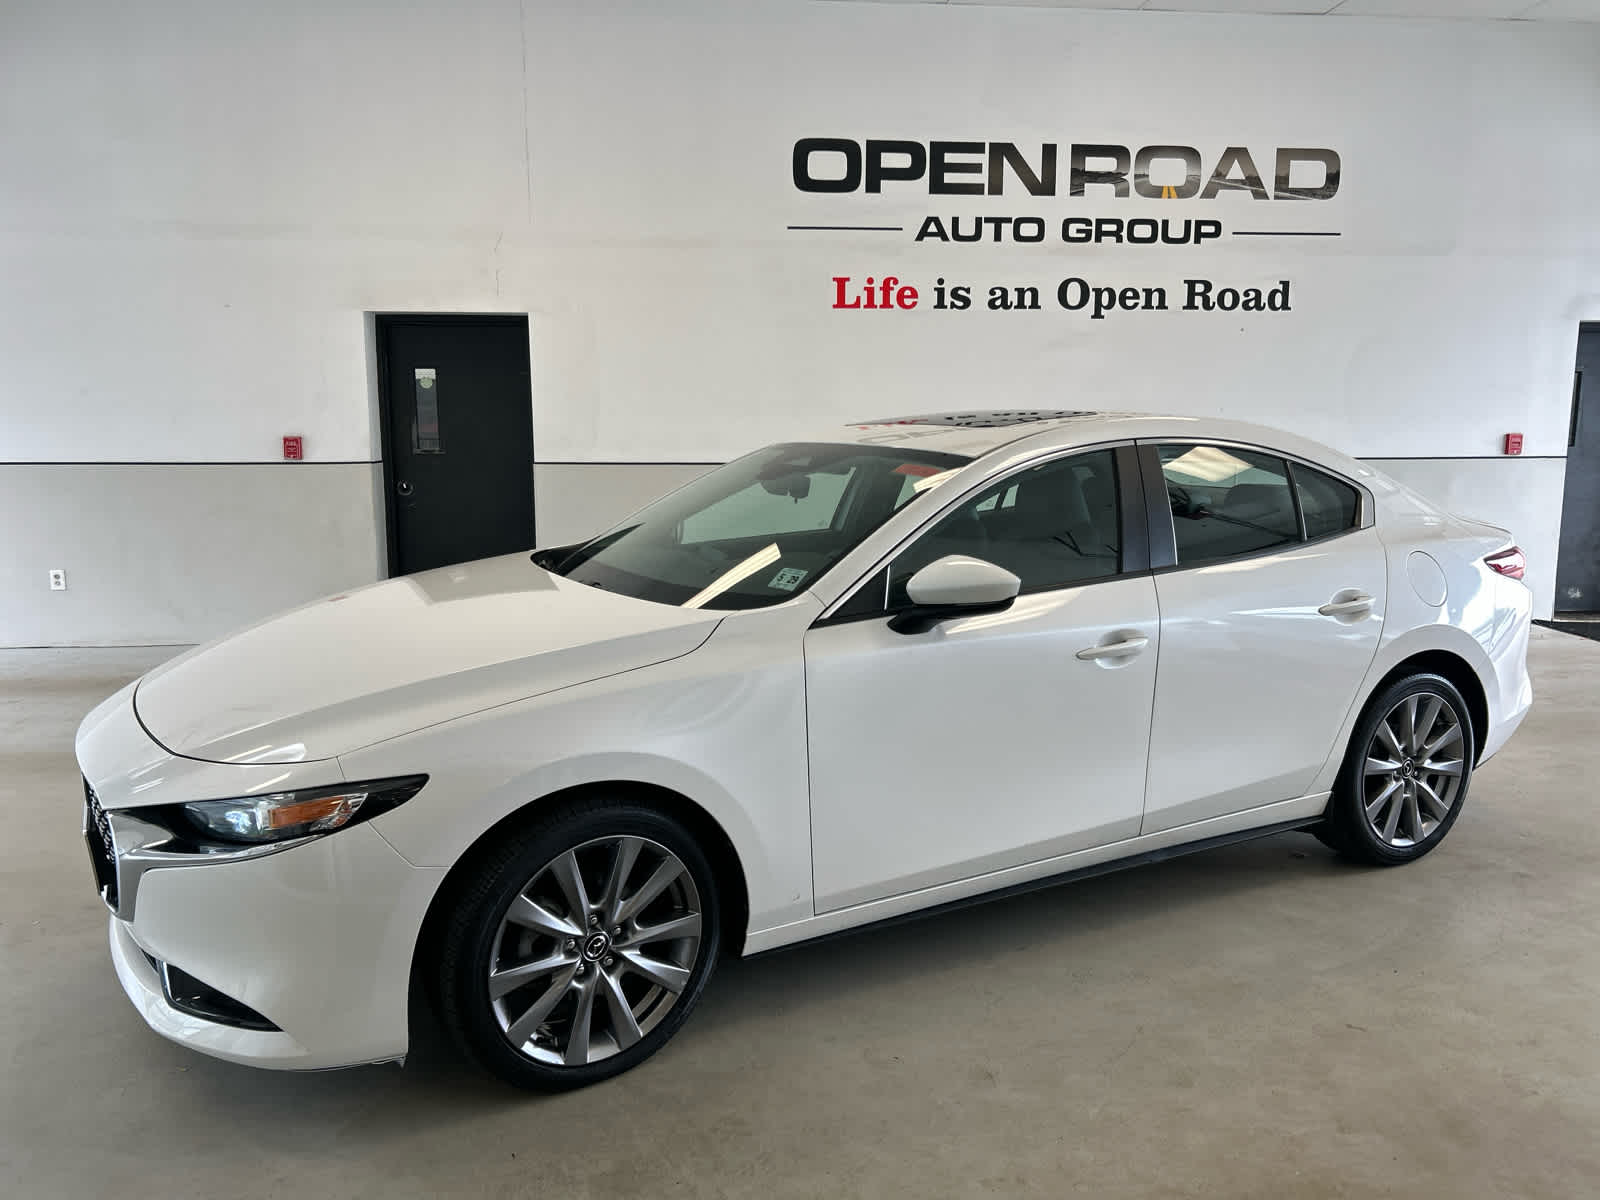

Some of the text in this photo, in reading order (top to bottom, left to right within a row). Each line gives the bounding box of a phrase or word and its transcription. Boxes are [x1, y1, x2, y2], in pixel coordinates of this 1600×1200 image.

[792, 137, 1342, 201] OPEN ROAD
[914, 215, 1223, 245] AUTO GROUP
[832, 276, 1292, 320] Life is an Open Road
